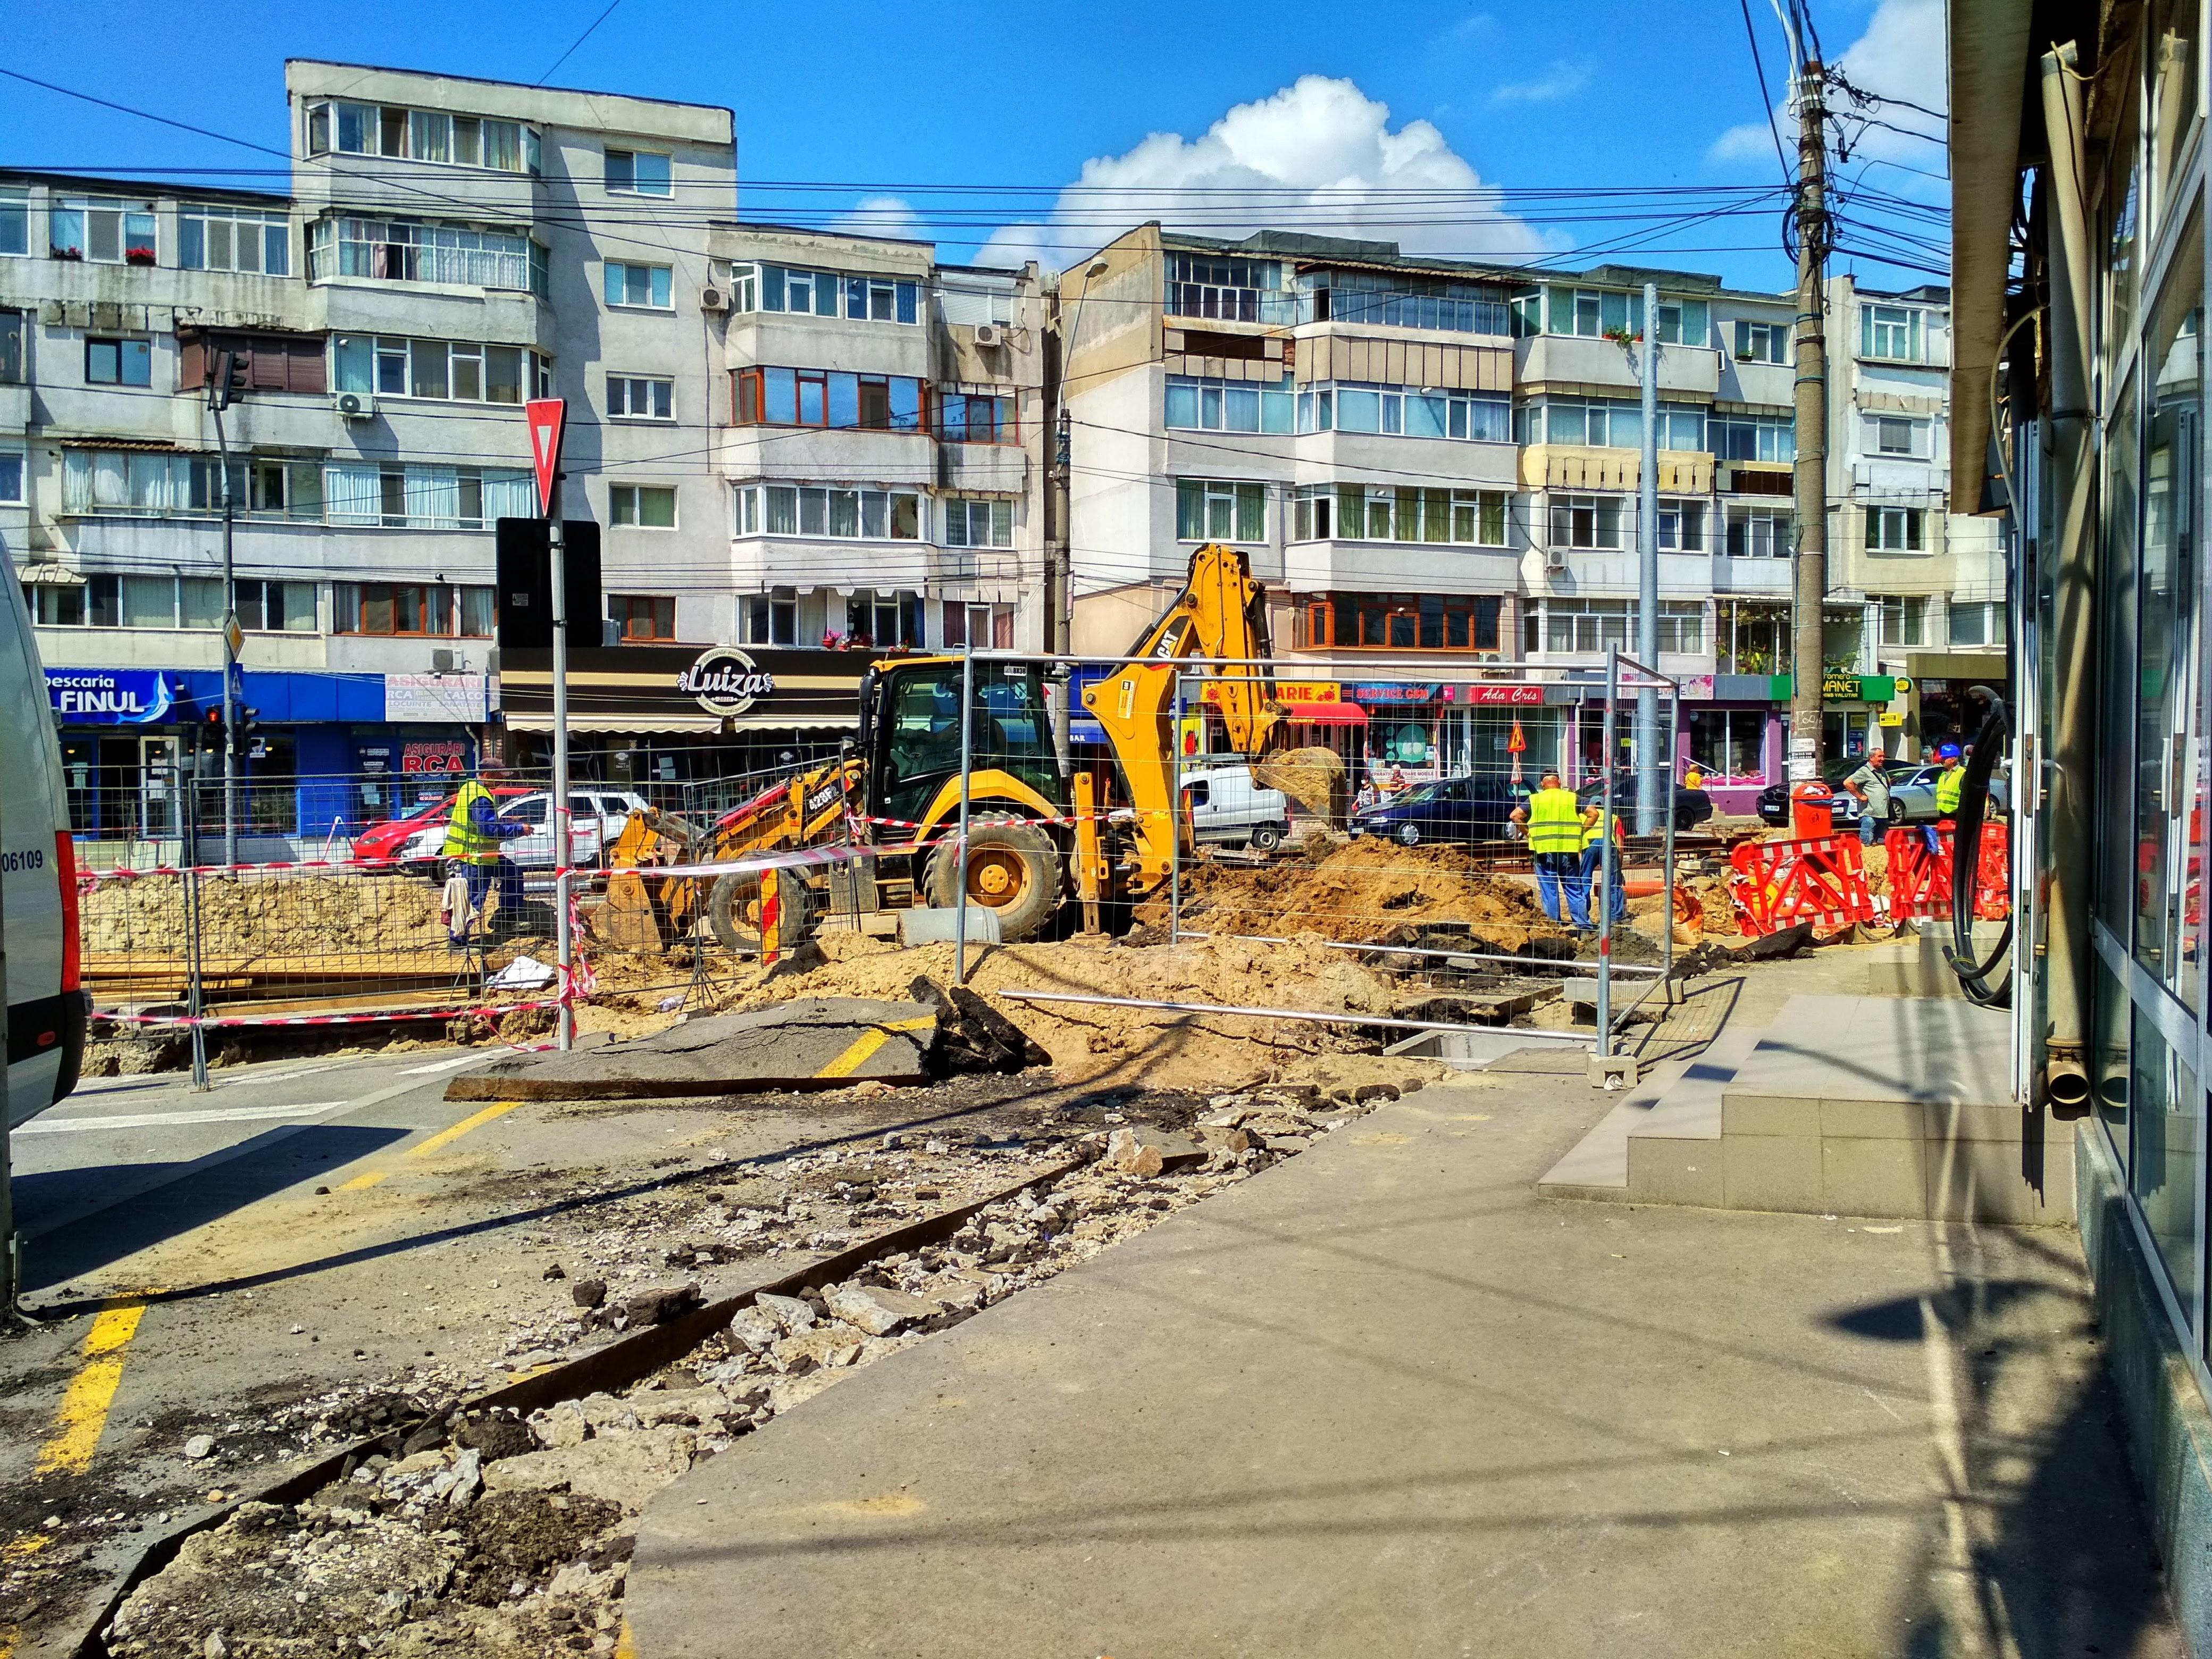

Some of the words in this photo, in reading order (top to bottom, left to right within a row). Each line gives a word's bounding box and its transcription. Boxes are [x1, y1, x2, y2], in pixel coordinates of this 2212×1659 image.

[1157, 630, 1179, 658] CAT
[688, 666, 764, 697] Luiza
[61, 691, 145, 713] FINUL
[387, 691, 413, 699] RCA
[444, 691, 483, 700] CASCO
[1356, 688, 1403, 699] SERVICE
[1405, 689, 1429, 700] GSM
[1480, 688, 1506, 700] Ada
[1511, 688, 1538, 702] Cris
[403, 755, 467, 777] RCA
[2, 850, 43, 873] 06109
